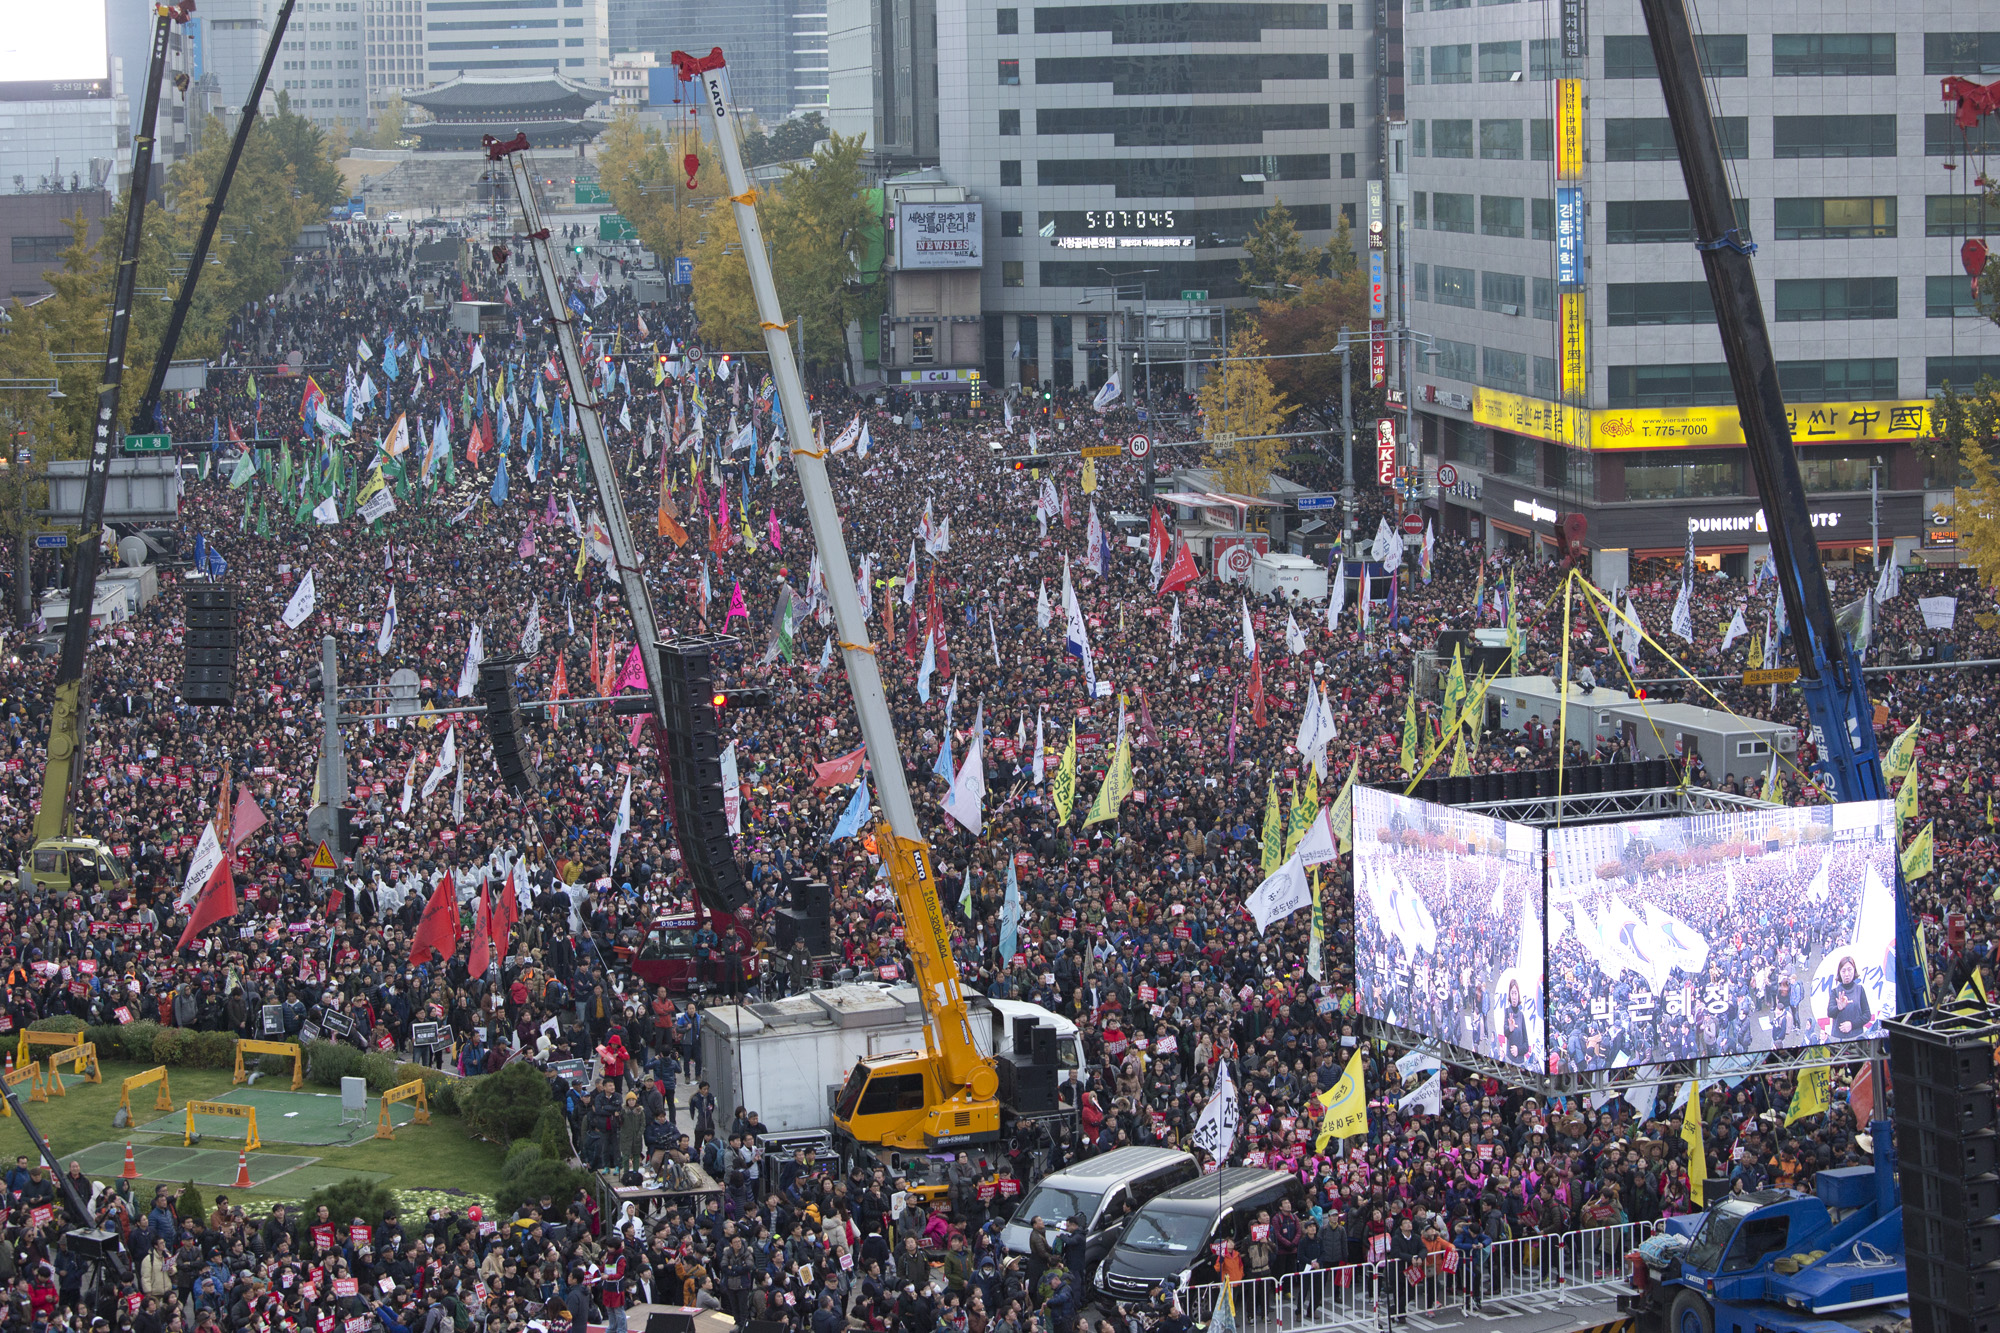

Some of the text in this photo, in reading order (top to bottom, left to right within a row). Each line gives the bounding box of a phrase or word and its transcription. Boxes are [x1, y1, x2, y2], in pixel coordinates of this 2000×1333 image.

[708, 79, 726, 118] KATO
[908, 211, 976, 224] 세상을 멈추게 할
[918, 222, 945, 234] 그들이
[917, 240, 969, 251] NEWSIES
[1182, 239, 1192, 247] 4F
[1559, 204, 1574, 283] 경동대학교
[690, 350, 699, 358] 60
[929, 372, 949, 381] CU
[1655, 424, 1708, 437] 775-7000
[134, 438, 161, 448] 시청
[1134, 441, 1145, 451] 60
[1379, 449, 1394, 485] KFC
[1441, 470, 1453, 482] 30
[1689, 516, 1753, 532] DUNKIN'
[1749, 671, 1795, 682] 신호 과속 단속장비
[913, 851, 926, 880] KATO
[926, 896, 948, 958] 010-3206-0404
[1591, 984, 1730, 1022] 박근혜정
[200, 1104, 241, 1116] 안전 제일
